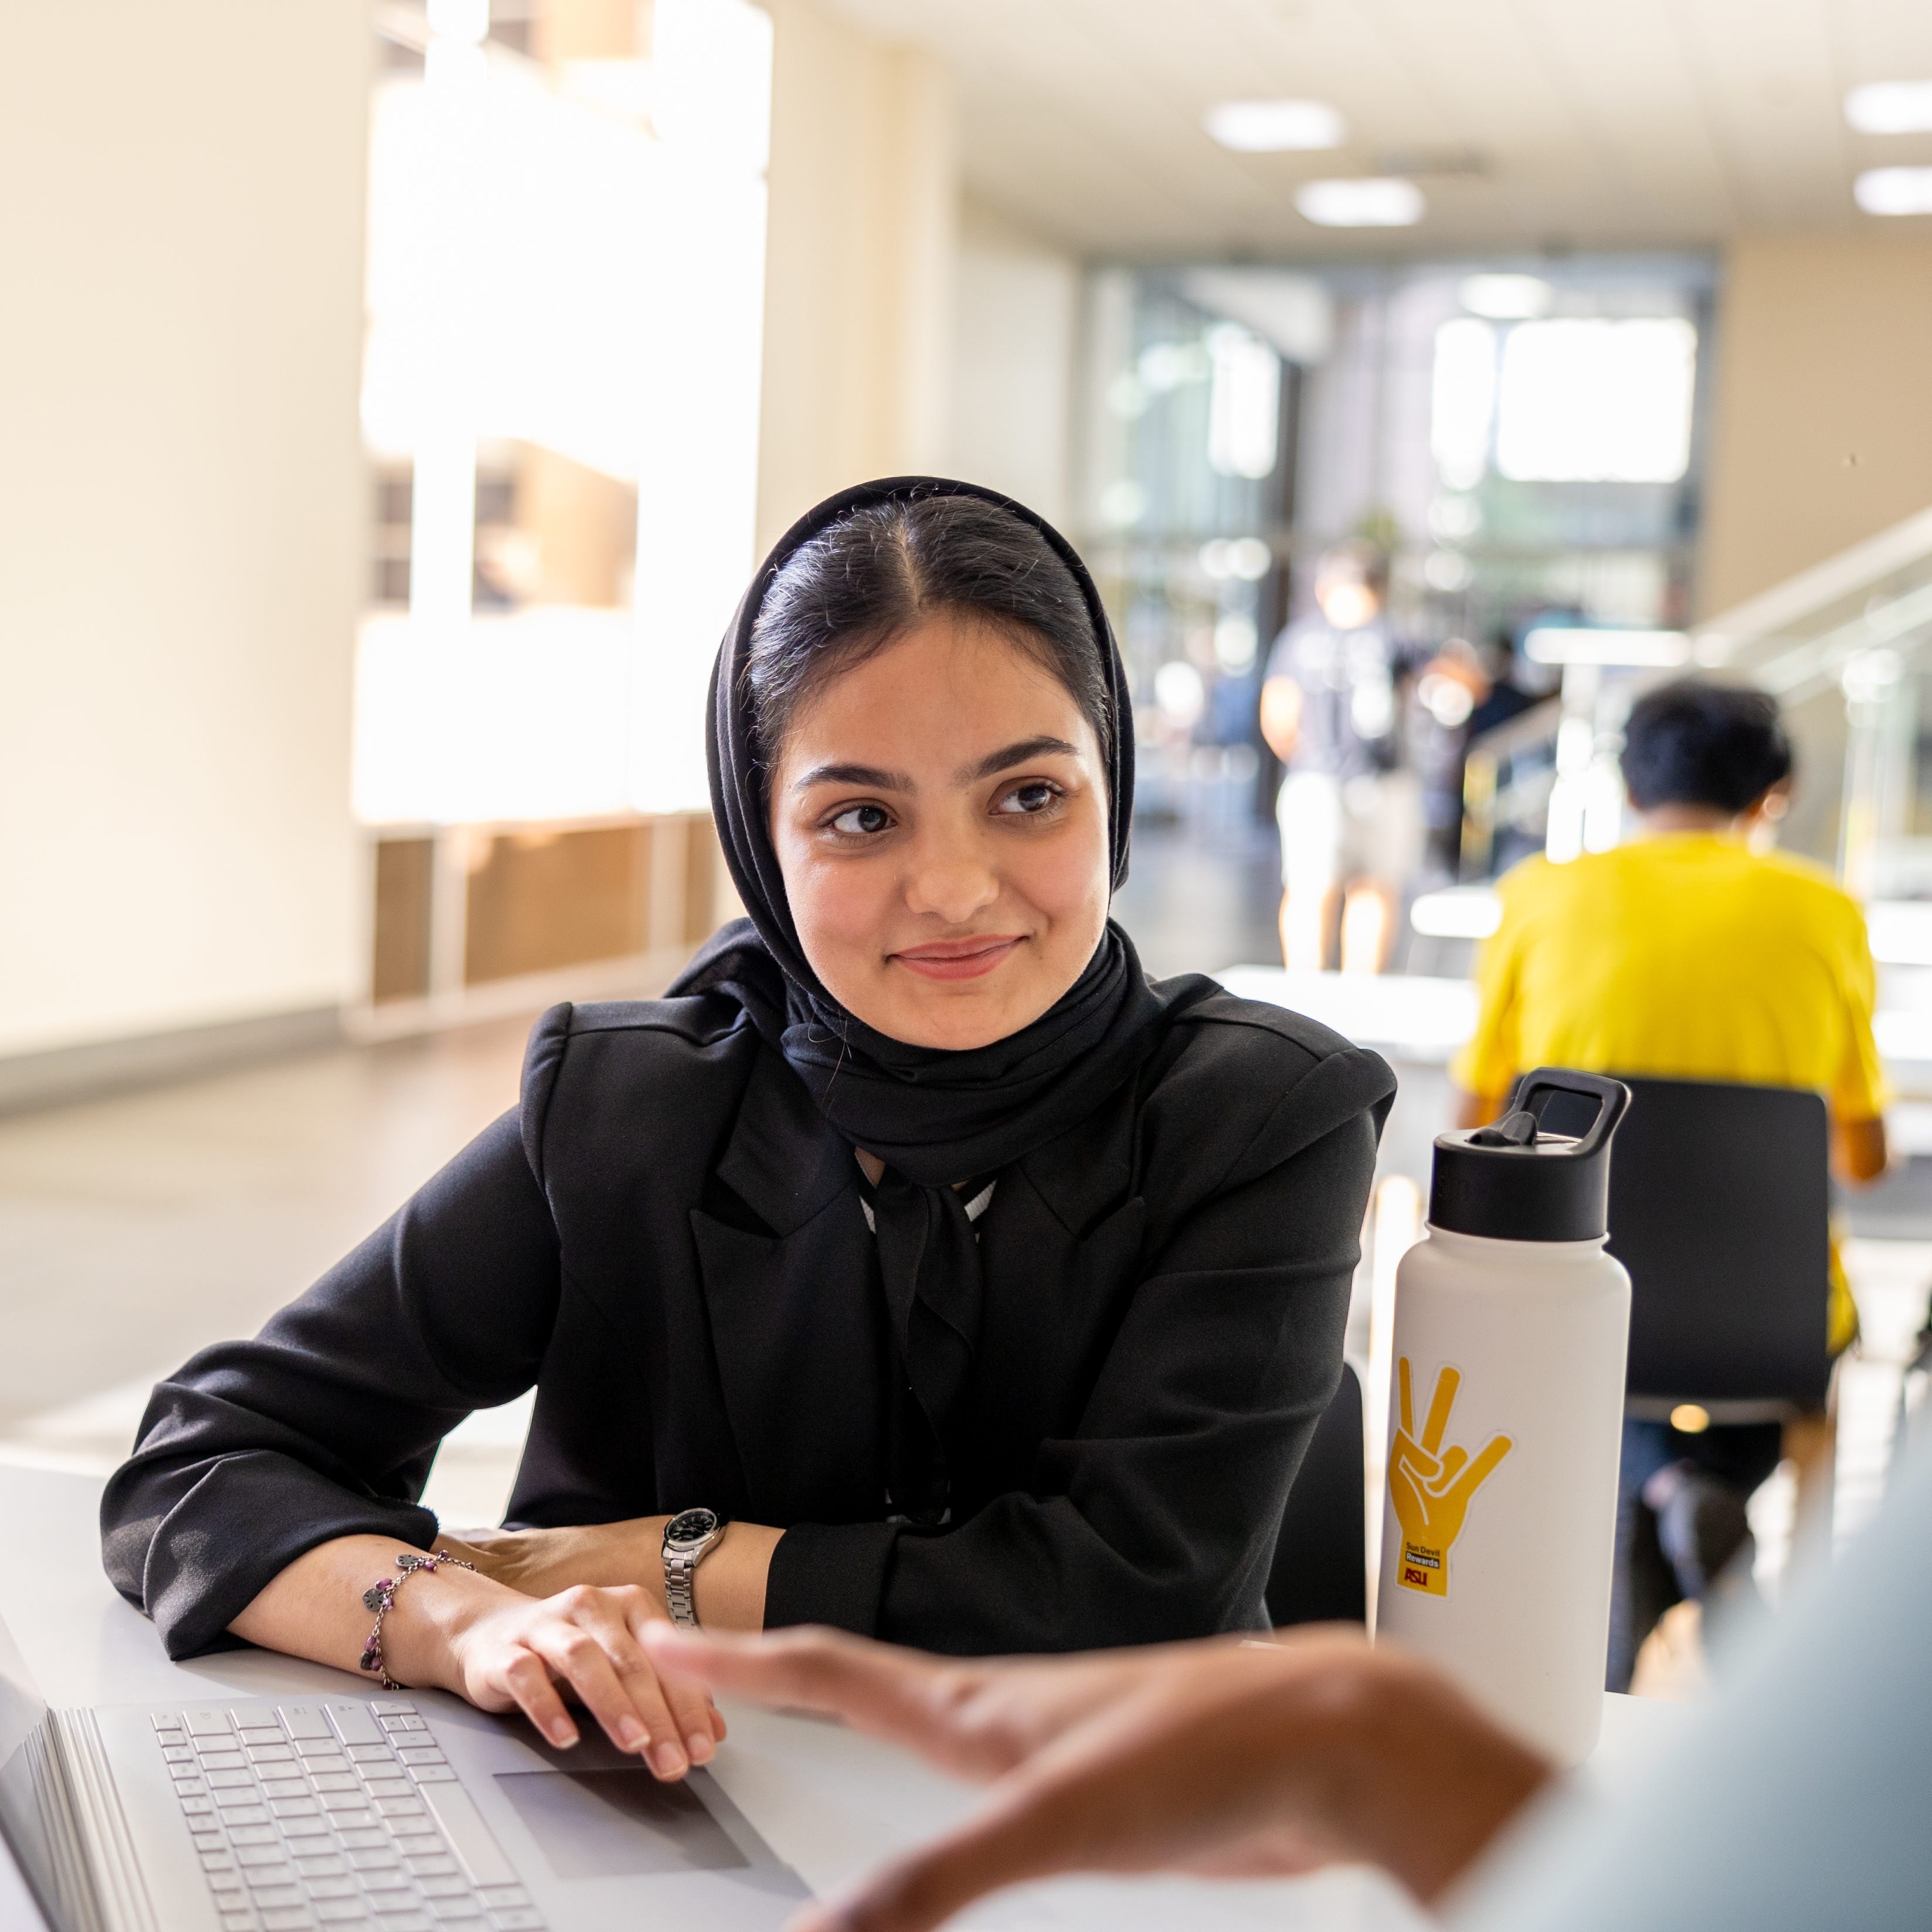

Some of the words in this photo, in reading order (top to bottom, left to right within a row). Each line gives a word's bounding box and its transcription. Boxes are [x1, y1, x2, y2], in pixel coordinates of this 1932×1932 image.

[1407, 1542, 1419, 1551] Sun
[1421, 1546, 1440, 1556] Devil
[1406, 1553, 1439, 1568] Rewards
[1405, 1567, 1428, 1586] ASU
